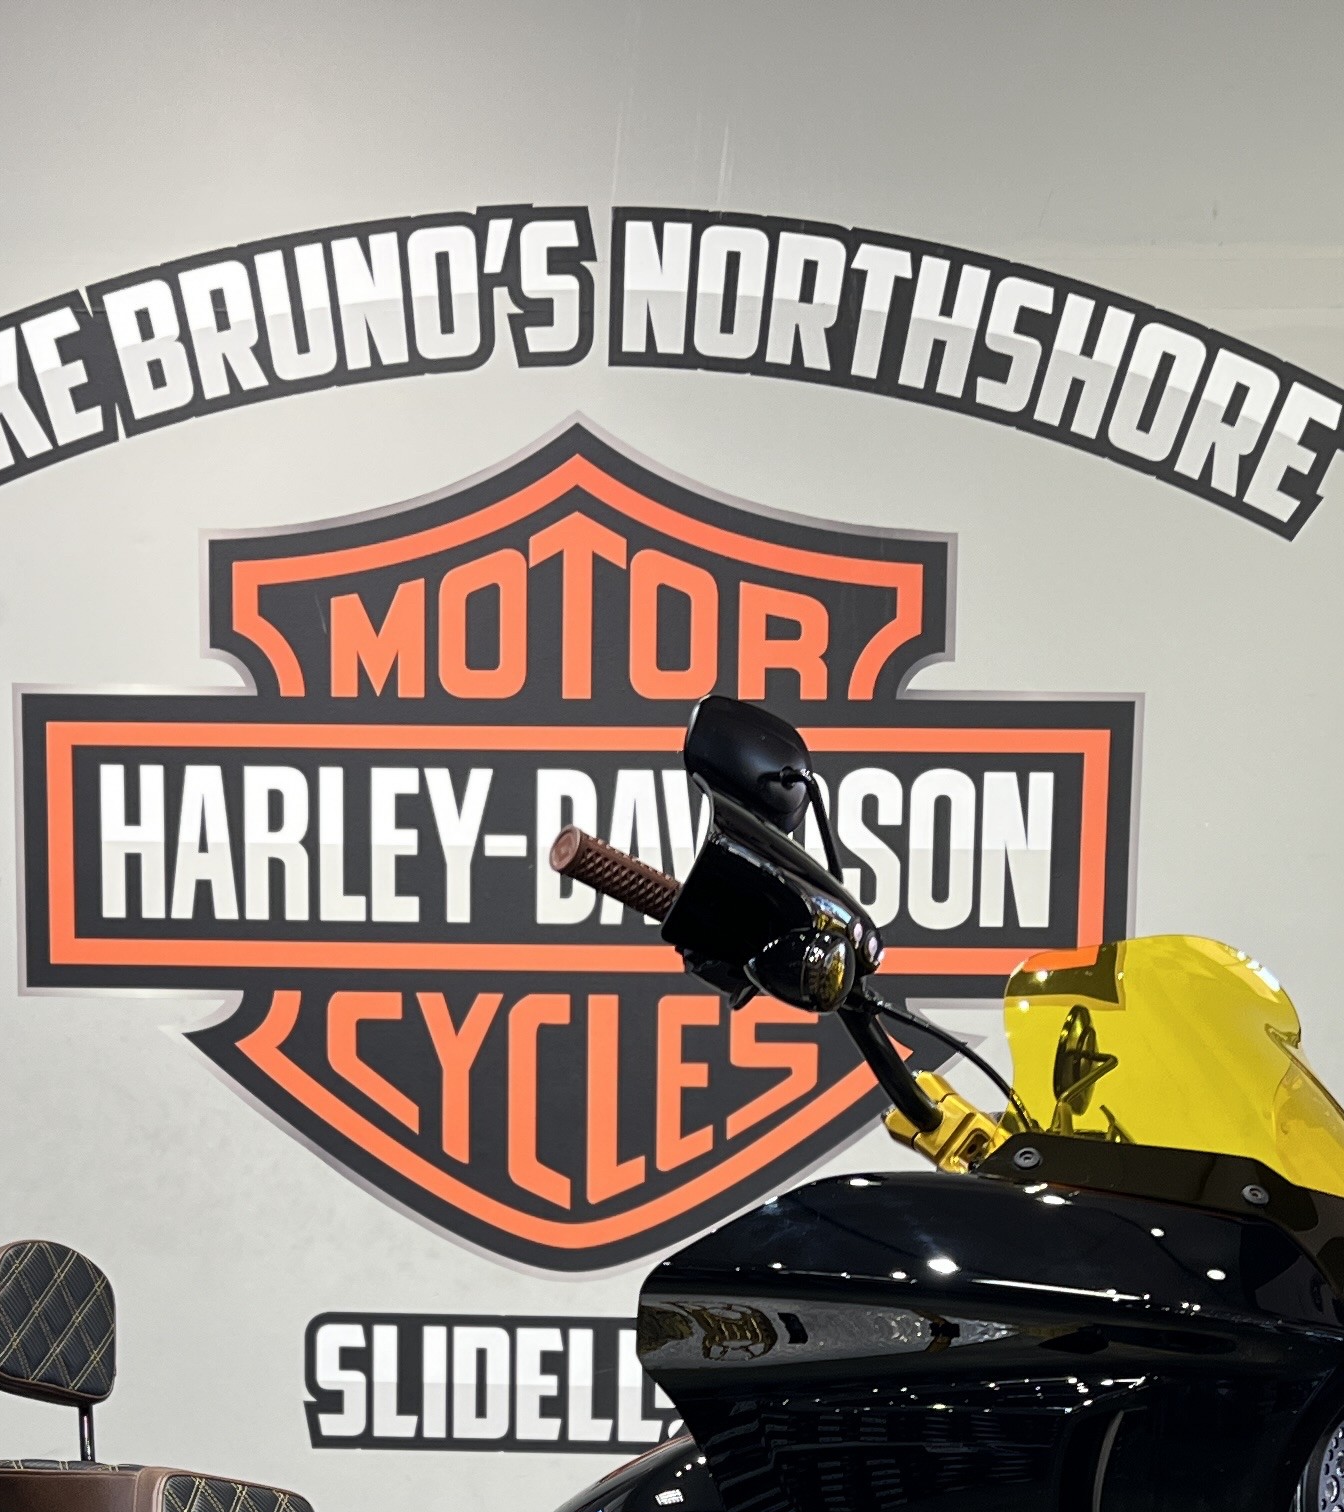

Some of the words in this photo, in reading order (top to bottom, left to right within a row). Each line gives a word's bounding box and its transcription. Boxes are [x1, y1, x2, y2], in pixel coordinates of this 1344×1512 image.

[102, 218, 581, 420] BRUNO'S
[621, 220, 1344, 523] NORTHSHORE
[329, 511, 830, 700] MOTOR
[98, 763, 1056, 930] HARLEY-DAVSON
[327, 991, 820, 1210] CYCLES
